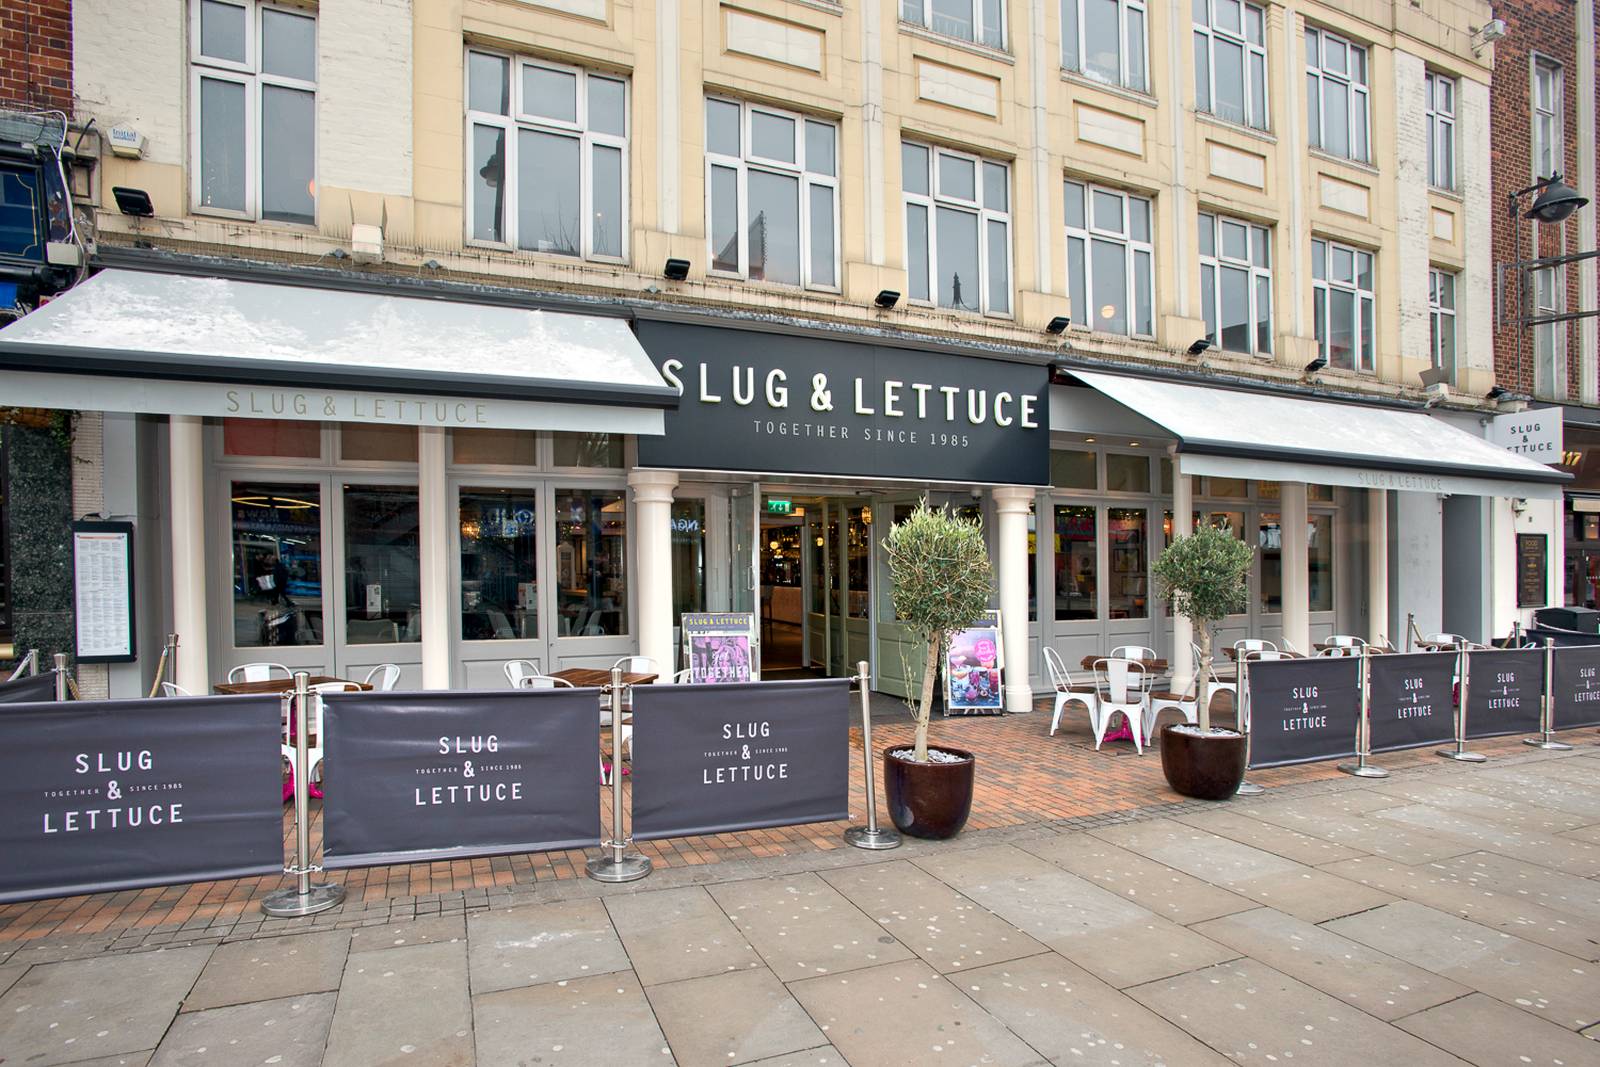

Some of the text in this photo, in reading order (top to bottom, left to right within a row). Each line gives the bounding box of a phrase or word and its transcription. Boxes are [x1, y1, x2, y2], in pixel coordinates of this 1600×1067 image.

[661, 358, 1039, 429] SLUG & LETTUCE
[226, 390, 487, 424] SLUG & LETTUCE
[753, 420, 969, 448] TOGETHER SINCE 1985
[1510, 423, 1541, 434] SLUG
[1522, 435, 1528, 443] &
[1358, 471, 1385, 486] SLUG
[693, 665, 750, 679] TOGETHER
[1497, 672, 1515, 683] SLUG
[1580, 667, 1595, 678] SLUG
[1404, 678, 1423, 690] SLUG
[1292, 686, 1318, 699] SLUG
[1302, 702, 1308, 713] &
[1488, 697, 1520, 709] LETTUCE
[1397, 705, 1432, 719] LETTUCE
[723, 721, 770, 739] SLUG
[1283, 716, 1327, 731] LETTUCE
[439, 735, 498, 755] SLUG
[741, 744, 751, 760] &
[75, 750, 152, 774] SLUG
[463, 760, 475, 778] &
[416, 767, 458, 775] TOGETHER
[703, 763, 788, 784] LETTUCE
[44, 788, 100, 798] TOGETHER
[107, 780, 122, 800] &
[415, 783, 522, 806] LETTUCE
[44, 804, 183, 833] LETTUCE
